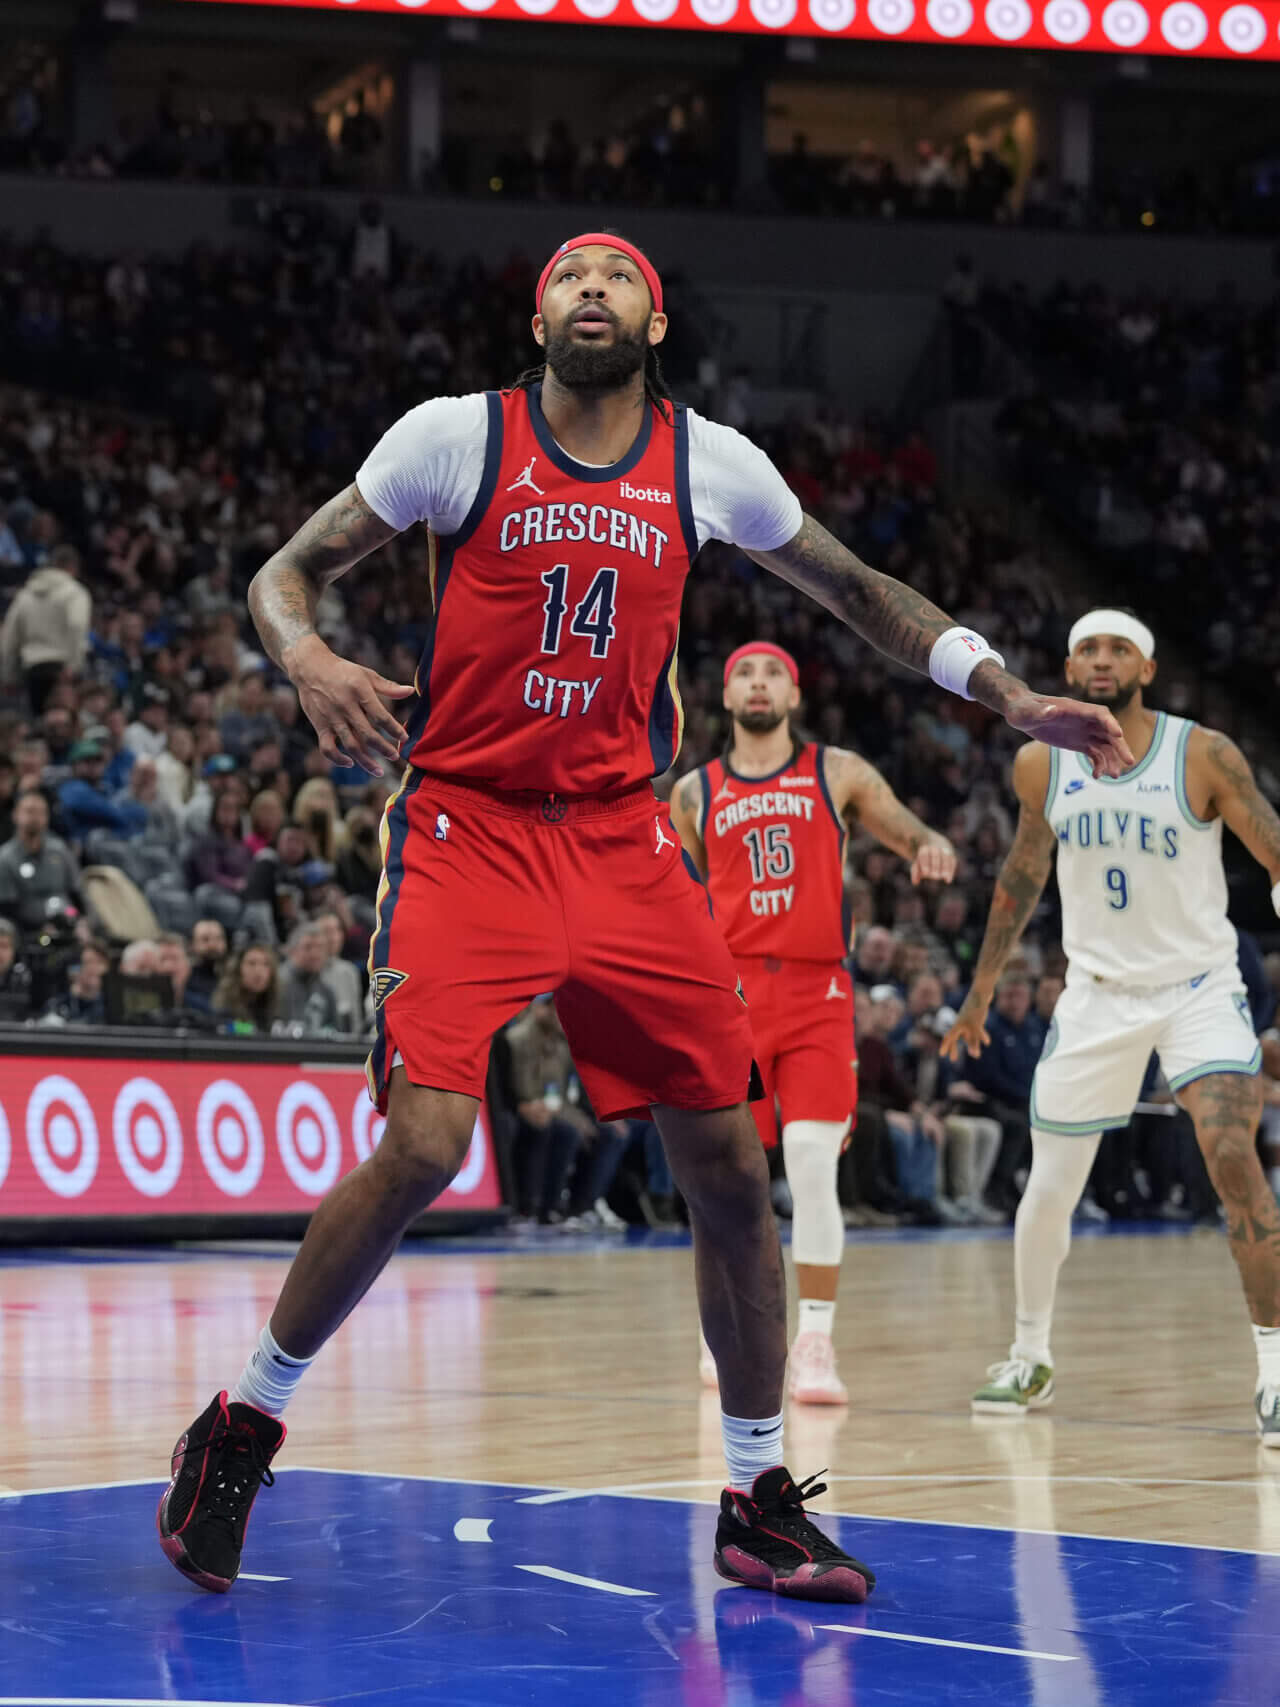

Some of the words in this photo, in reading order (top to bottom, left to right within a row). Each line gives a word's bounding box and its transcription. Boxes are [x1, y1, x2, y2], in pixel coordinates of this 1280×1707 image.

[620, 482, 672, 504] ibotta
[500, 502, 669, 569] CRESCENT
[540, 563, 619, 659] 14
[523, 668, 603, 718] CITY
[714, 791, 815, 838] CRESCENT
[1054, 807, 1179, 860] WOLVES
[742, 823, 795, 884] 15
[749, 885, 795, 917] CITY
[1104, 866, 1130, 912] 9
